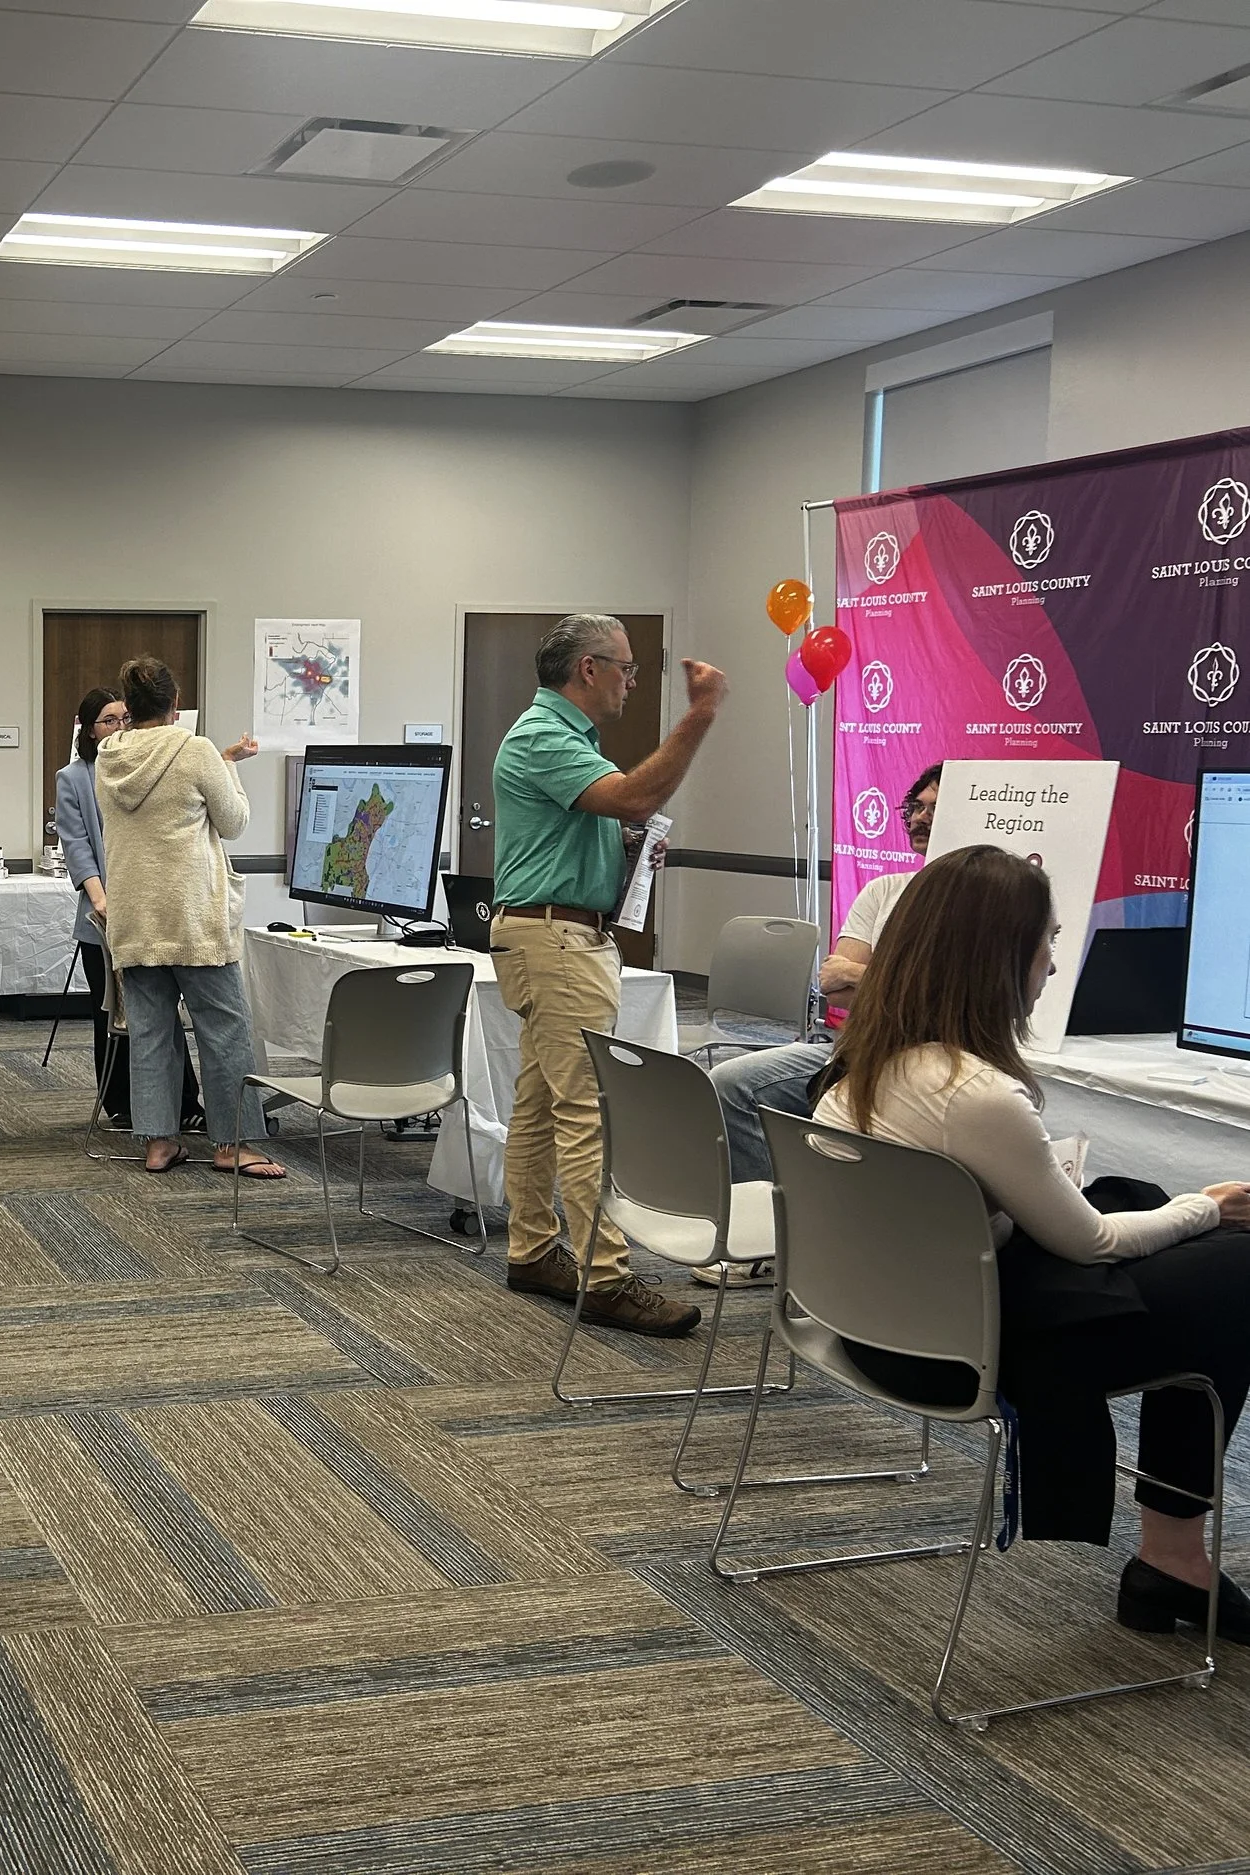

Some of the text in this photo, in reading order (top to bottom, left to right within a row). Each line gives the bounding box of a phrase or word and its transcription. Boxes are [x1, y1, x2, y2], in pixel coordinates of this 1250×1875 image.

[1152, 563, 1192, 579] SAINT
[972, 575, 1091, 598] SAINT LOUIS COUNTY
[860, 595, 887, 607] LOUIS
[888, 592, 928, 604] COUNTY
[882, 724, 922, 734] COUNTY
[966, 723, 1083, 734] SAINT LOUIS COUNTY
[1143, 722, 1181, 734] SAINT
[969, 784, 1069, 807] Leading the
[984, 812, 1044, 834] Region
[880, 850, 916, 864] COUNTY
[1134, 874, 1178, 888] SAINT
